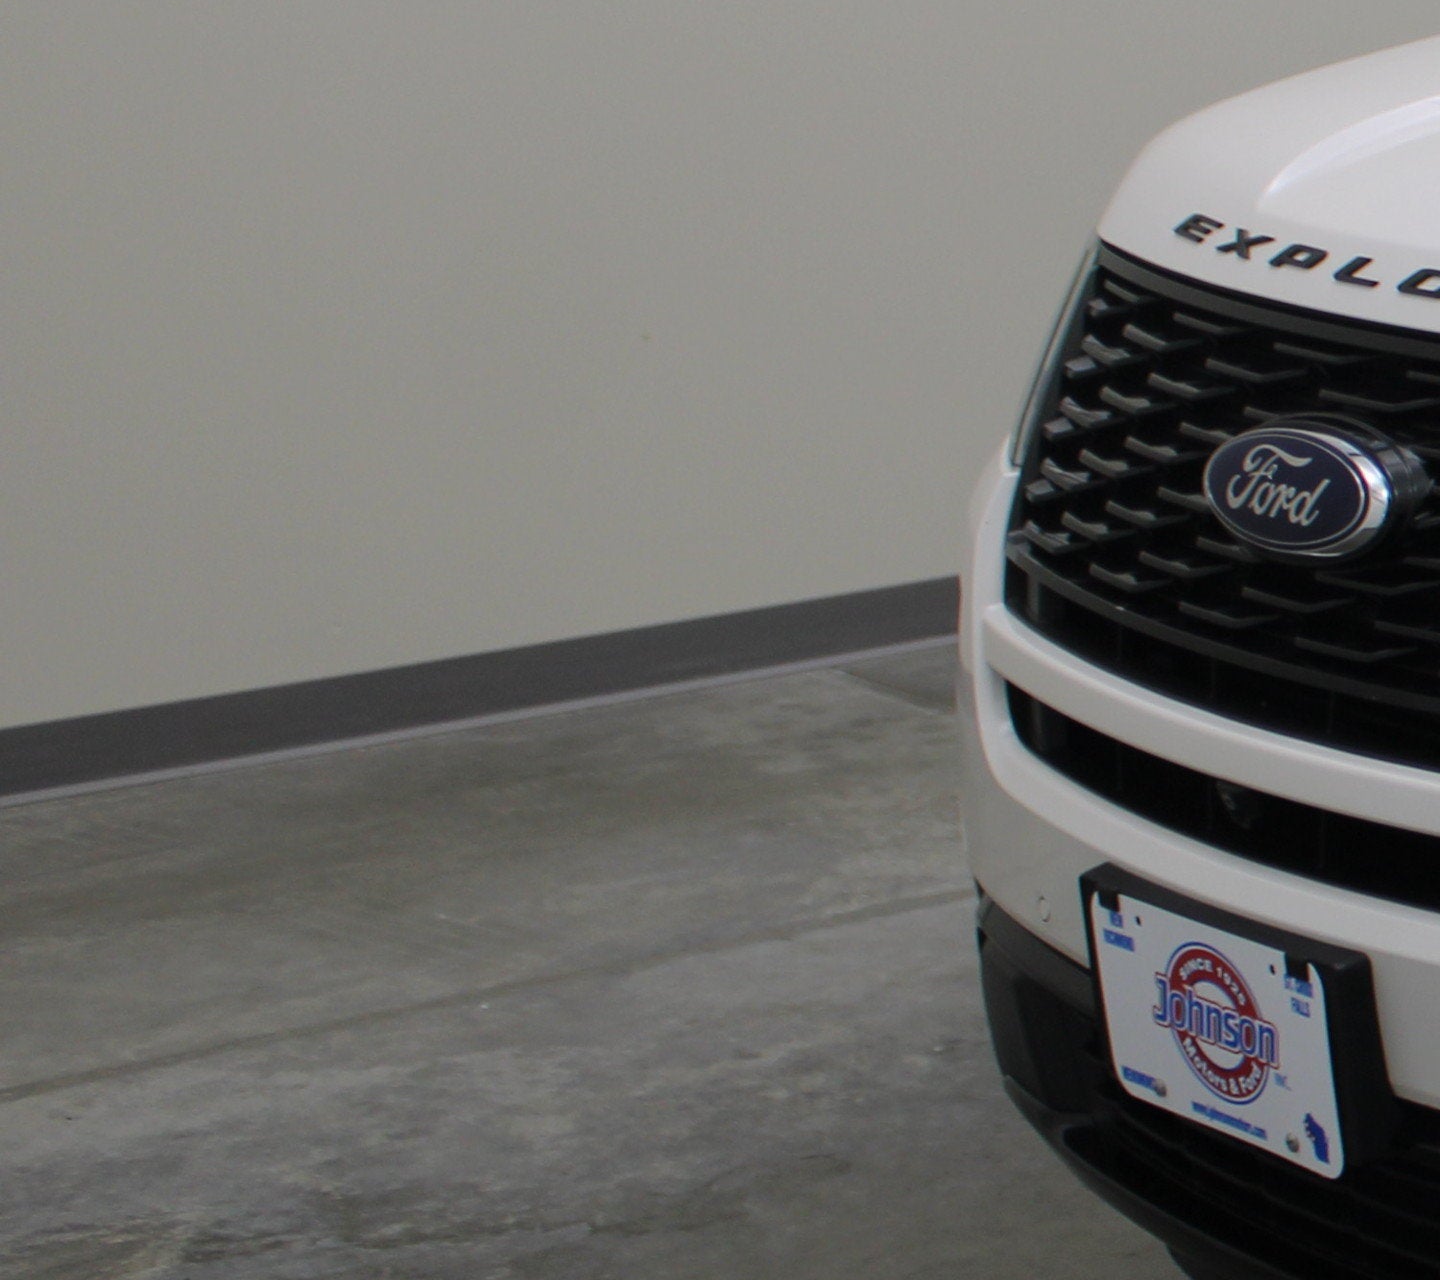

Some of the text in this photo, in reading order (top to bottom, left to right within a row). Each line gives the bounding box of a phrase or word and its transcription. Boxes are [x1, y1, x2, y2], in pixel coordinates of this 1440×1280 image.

[1225, 443, 1331, 527] Ford
[1153, 974, 1279, 1067] Johnson
[1182, 1036, 1228, 1094] Motors
